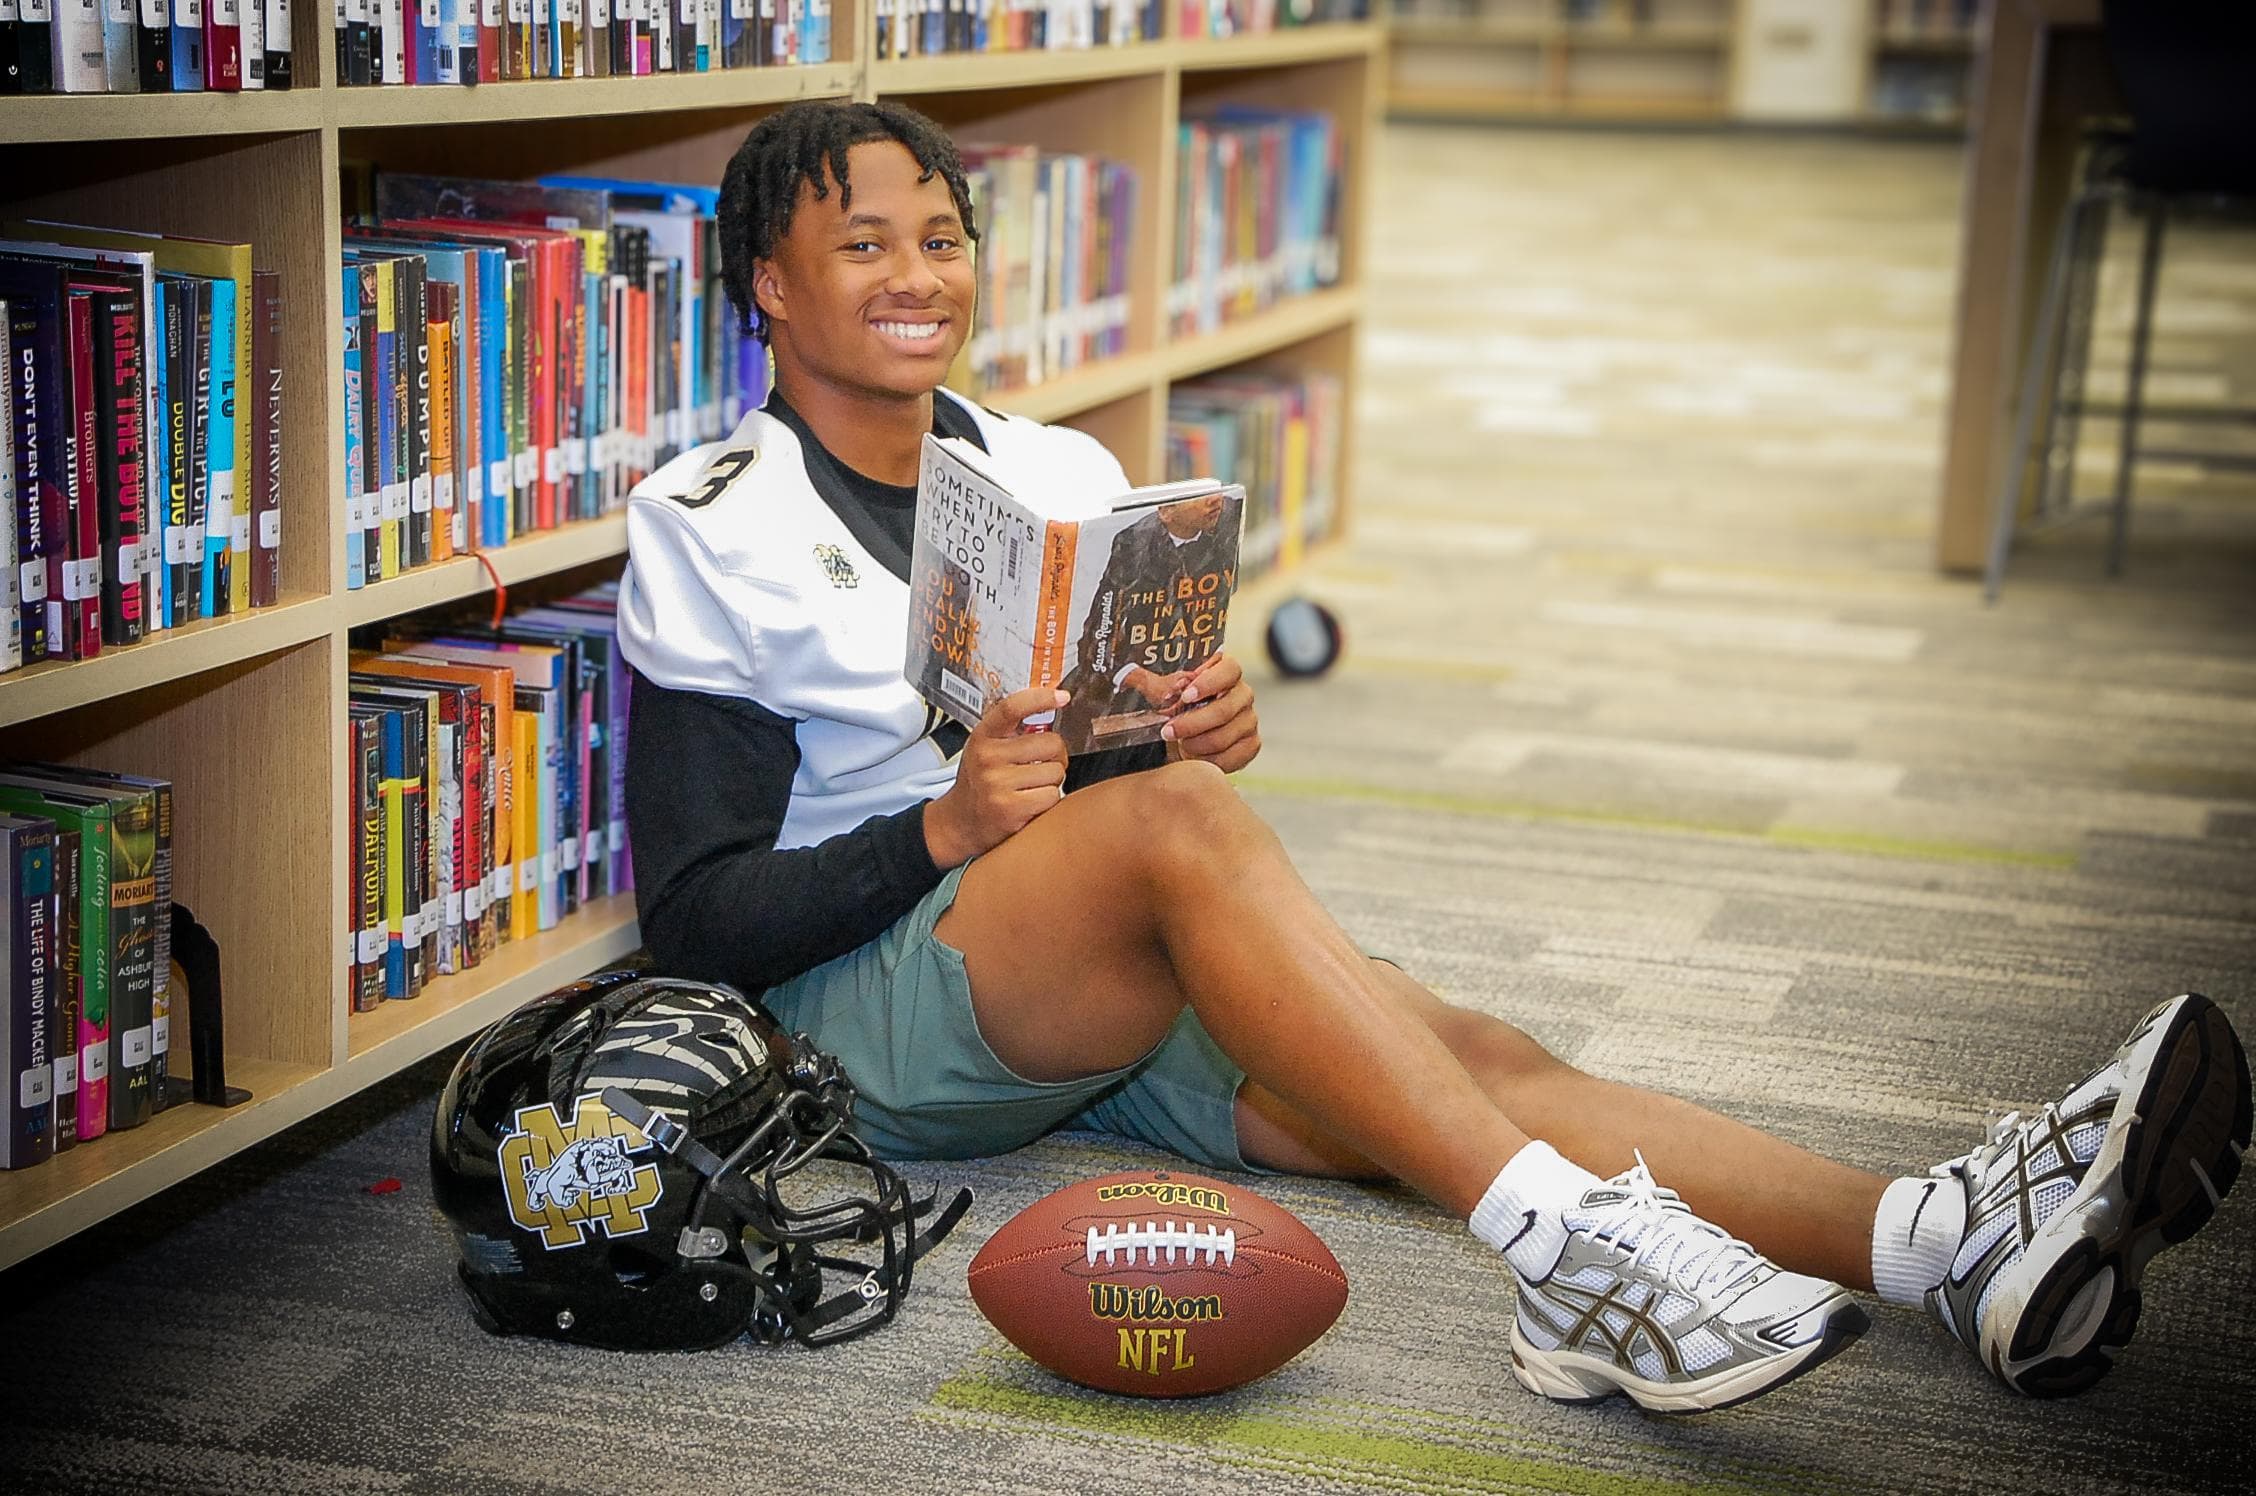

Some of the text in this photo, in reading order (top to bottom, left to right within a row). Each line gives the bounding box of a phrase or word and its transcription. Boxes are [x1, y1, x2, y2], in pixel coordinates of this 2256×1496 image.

[418, 281, 427, 333] MURPHY
[113, 314, 137, 386] KILL
[244, 283, 252, 380] FLANNERY
[197, 366, 212, 427] GIRL
[442, 340, 450, 450] BOTTLED UP
[84, 409, 96, 485] Brothers
[116, 396, 139, 456] THE
[268, 367, 283, 505] NEVERWAS
[345, 369, 363, 498] DAIRY QUE
[23, 348, 41, 551] DON'T EVEN THINK
[170, 400, 186, 525] DOUBLE DIG
[924, 478, 976, 528] WHEN
[923, 499, 985, 553] TRY TO
[945, 537, 985, 574] TOO
[1130, 589, 1166, 609] THE
[1153, 596, 1217, 620] IN THE
[1046, 621, 1057, 645] BOY
[1142, 635, 1216, 666] SUIT
[30, 899, 44, 927] THE
[132, 915, 147, 926] THE
[30, 928, 44, 956] LIFE
[134, 948, 145, 958] OF
[30, 957, 44, 975] OF
[127, 977, 151, 993] HIGH
[31, 978, 45, 1016] BINDY
[1096, 1182, 1230, 1216] Wilson
[1088, 1281, 1222, 1322] Wilson
[1117, 1327, 1196, 1376] NFL
